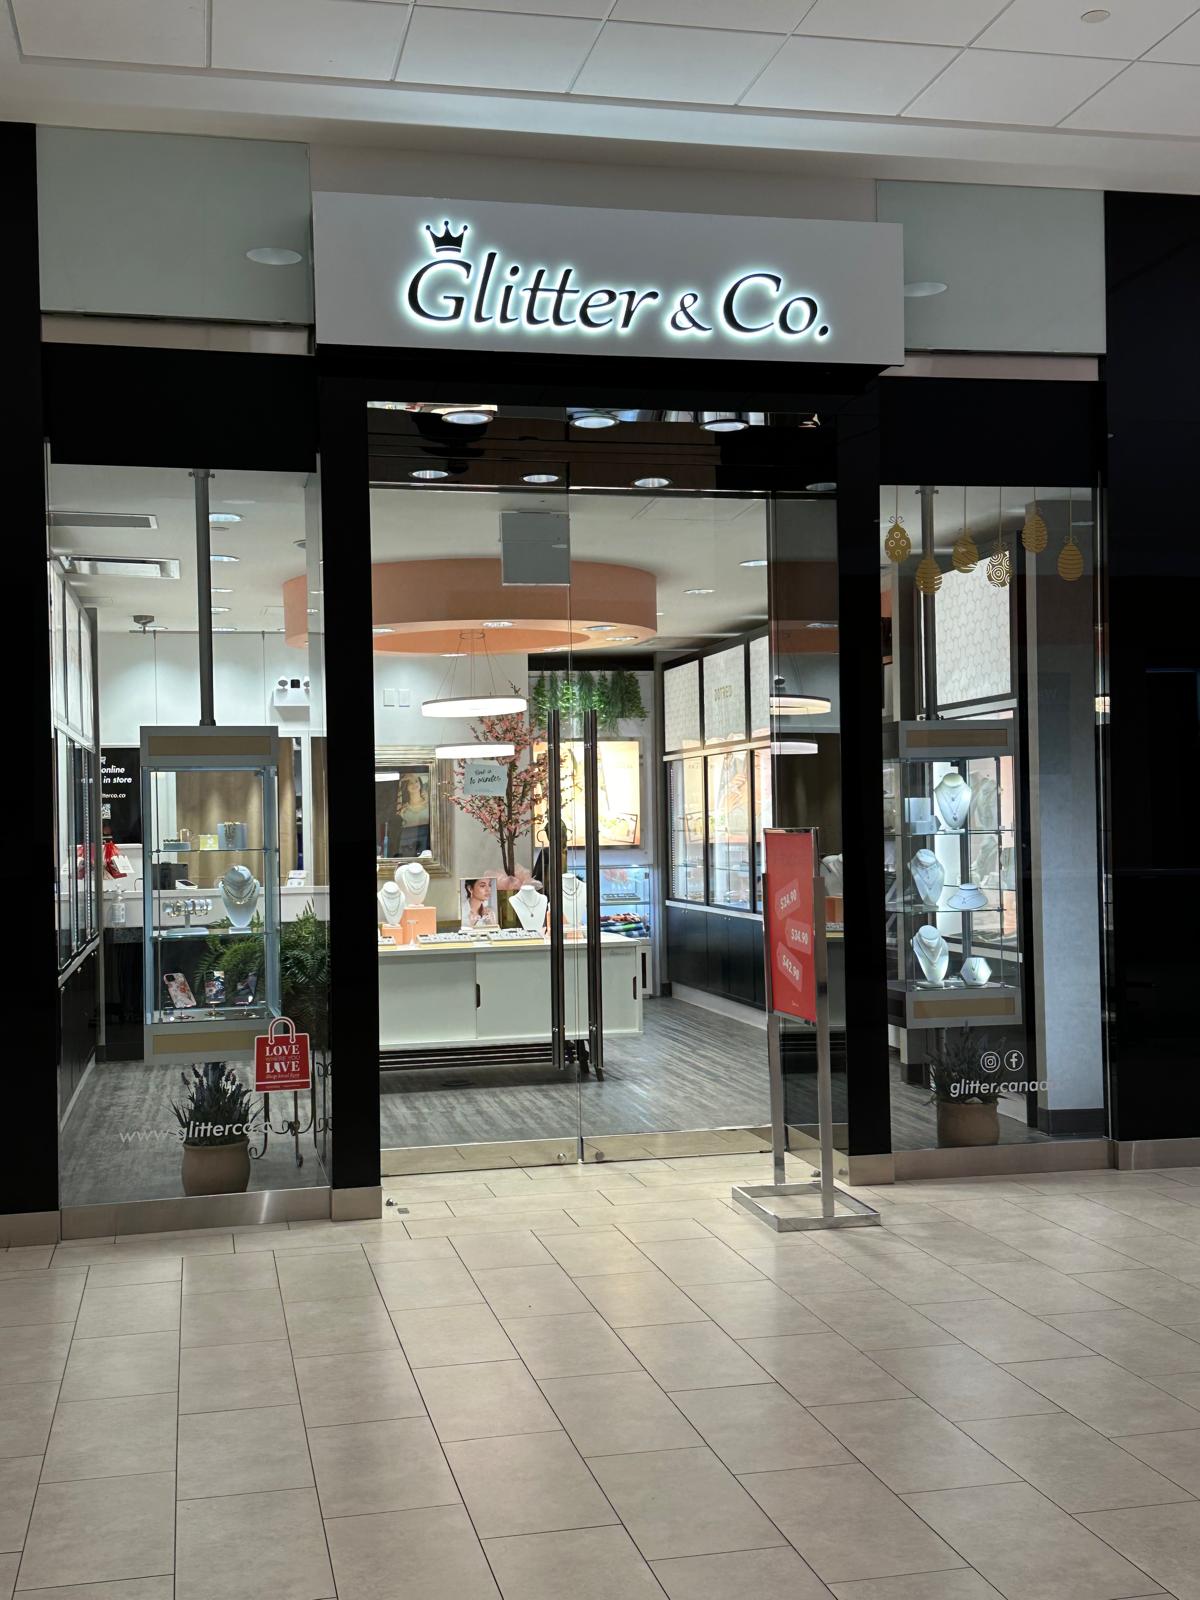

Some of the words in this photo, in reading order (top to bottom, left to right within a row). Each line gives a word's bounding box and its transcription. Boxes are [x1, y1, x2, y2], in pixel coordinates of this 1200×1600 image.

[407, 251, 658, 329] Glitter
[669, 291, 713, 332] &
[722, 273, 830, 337] Co.
[101, 765, 126, 773] online
[265, 1044, 300, 1056] LOVE
